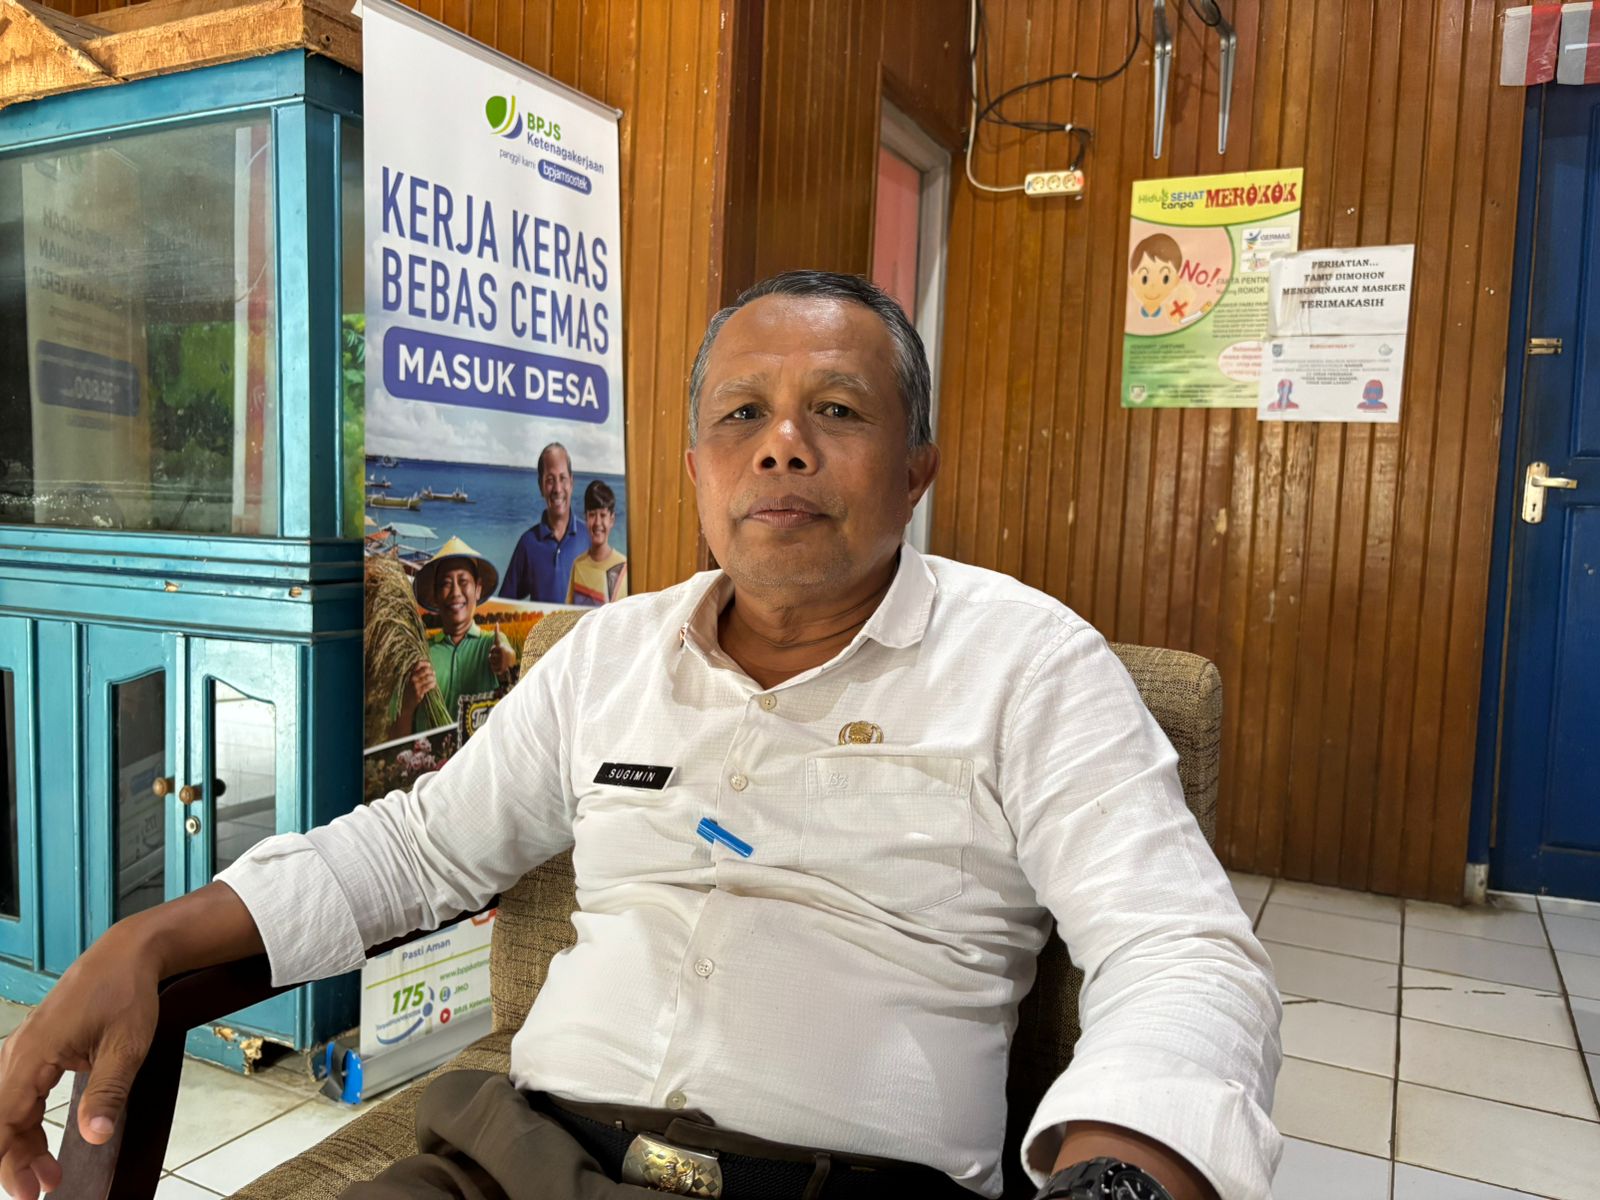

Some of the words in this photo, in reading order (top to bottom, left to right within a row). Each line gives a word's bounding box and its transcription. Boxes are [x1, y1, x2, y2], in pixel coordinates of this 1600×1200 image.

[527, 112, 561, 141] BPJS
[522, 156, 536, 169] kami
[527, 132, 604, 174] Ketenagakerjaan
[543, 161, 588, 191] bpjamsostek
[1161, 200, 1194, 210] tanpa
[1171, 190, 1204, 202] SEHAT
[1205, 181, 1297, 208] MEROKOK
[382, 166, 499, 263] KERJA
[512, 209, 608, 292] KERAS
[1180, 259, 1221, 288] No!
[1311, 259, 1379, 269] PERHATIAN...
[1241, 275, 1269, 285] PENTIN
[1304, 273, 1333, 282] TAMU
[1335, 271, 1385, 281] DIMOHON
[382, 247, 497, 331] BEBAS
[511, 281, 609, 355] CEMAS
[1282, 286, 1359, 296] MENGGUNAKAN
[1361, 284, 1406, 293] MASKER
[1300, 298, 1385, 310] TERIMAKASIH
[399, 344, 516, 397] MASUK
[525, 365, 599, 409] DESA
[608, 768, 656, 782] SUGIMIN
[402, 945, 424, 961] Pasti
[426, 938, 451, 954] Aman
[393, 981, 425, 1015] 175
